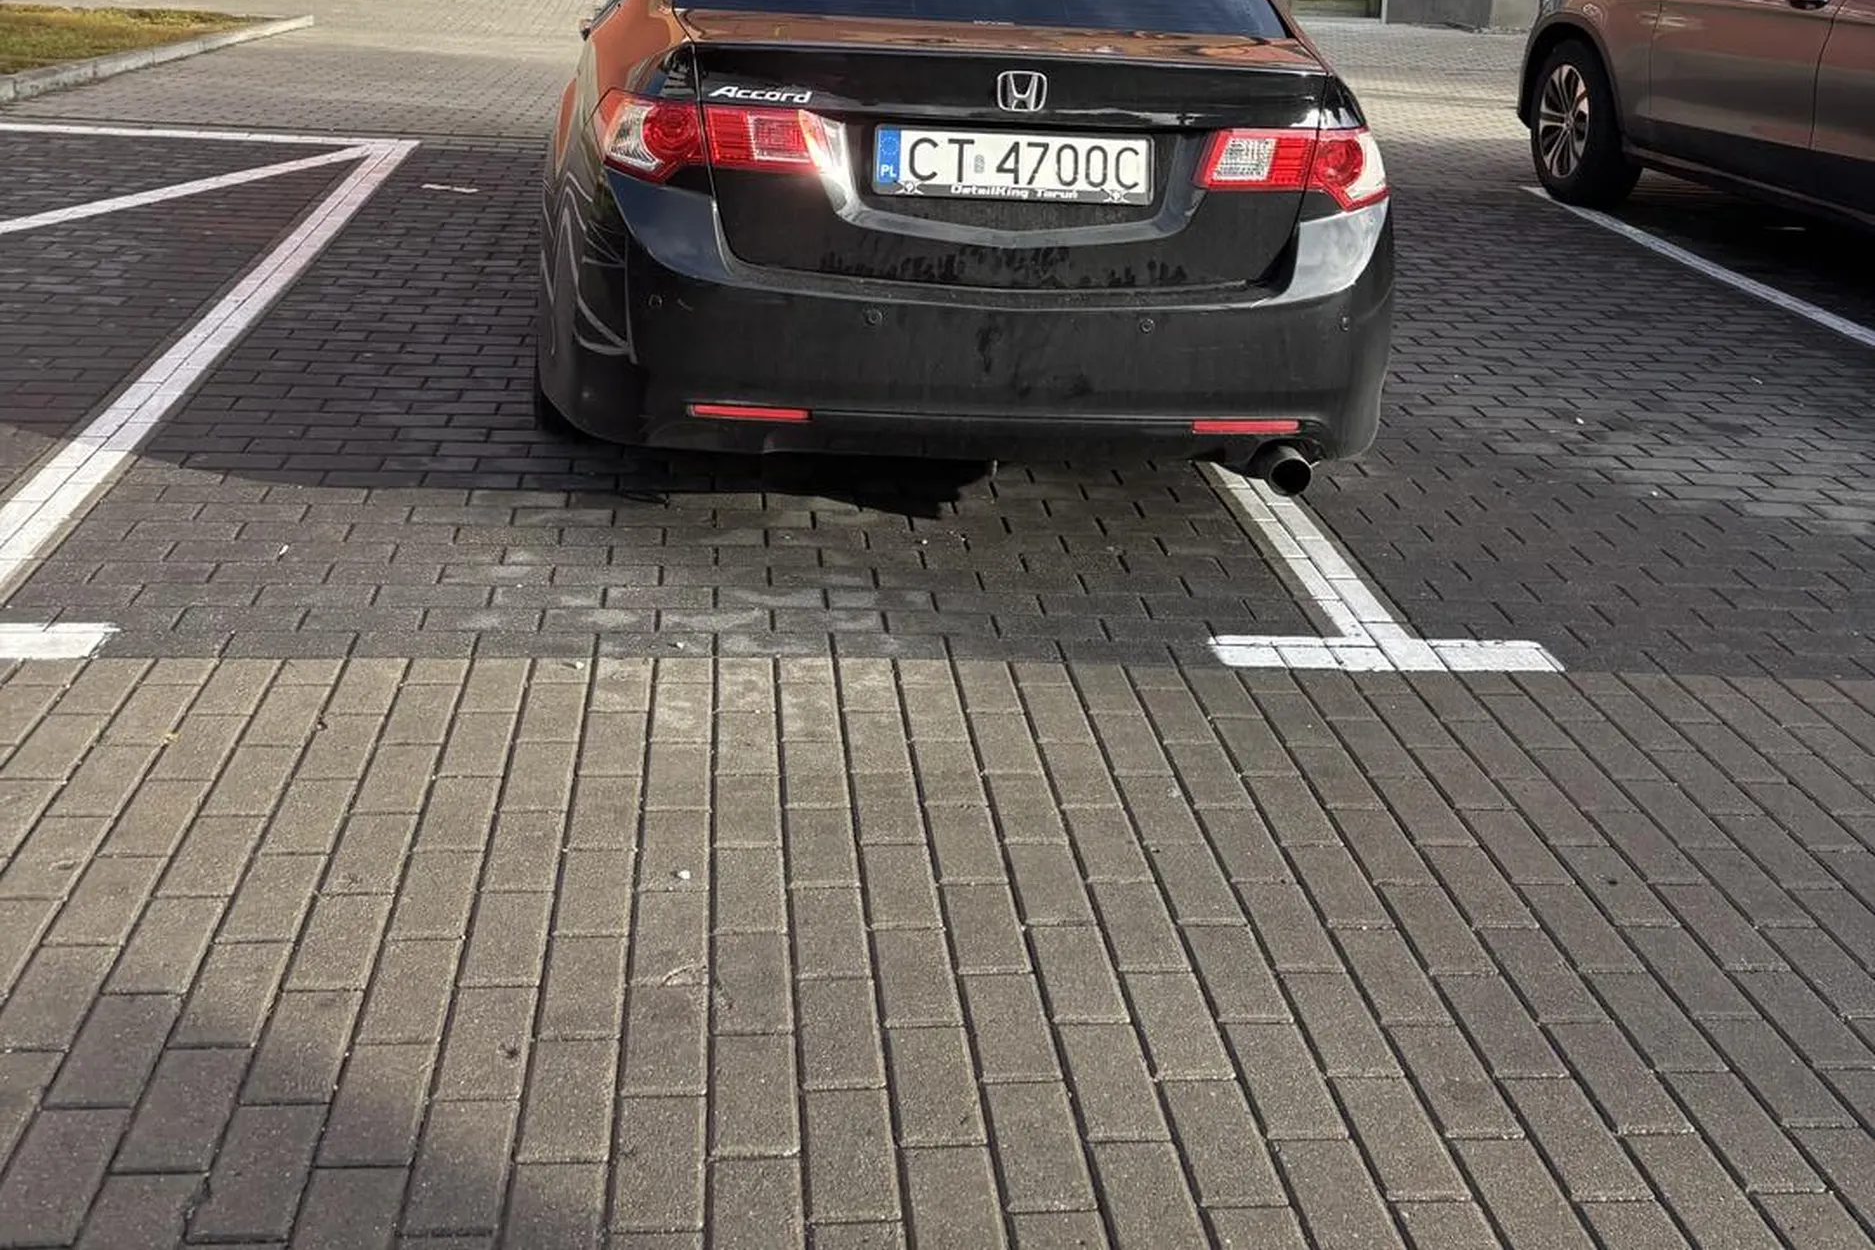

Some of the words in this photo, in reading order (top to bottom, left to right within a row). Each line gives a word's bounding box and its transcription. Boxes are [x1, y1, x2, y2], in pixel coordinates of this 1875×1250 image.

[708, 85, 813, 103] Accord
[880, 165, 897, 178] PL
[908, 137, 975, 183] CT
[996, 141, 1140, 190] 4700C
